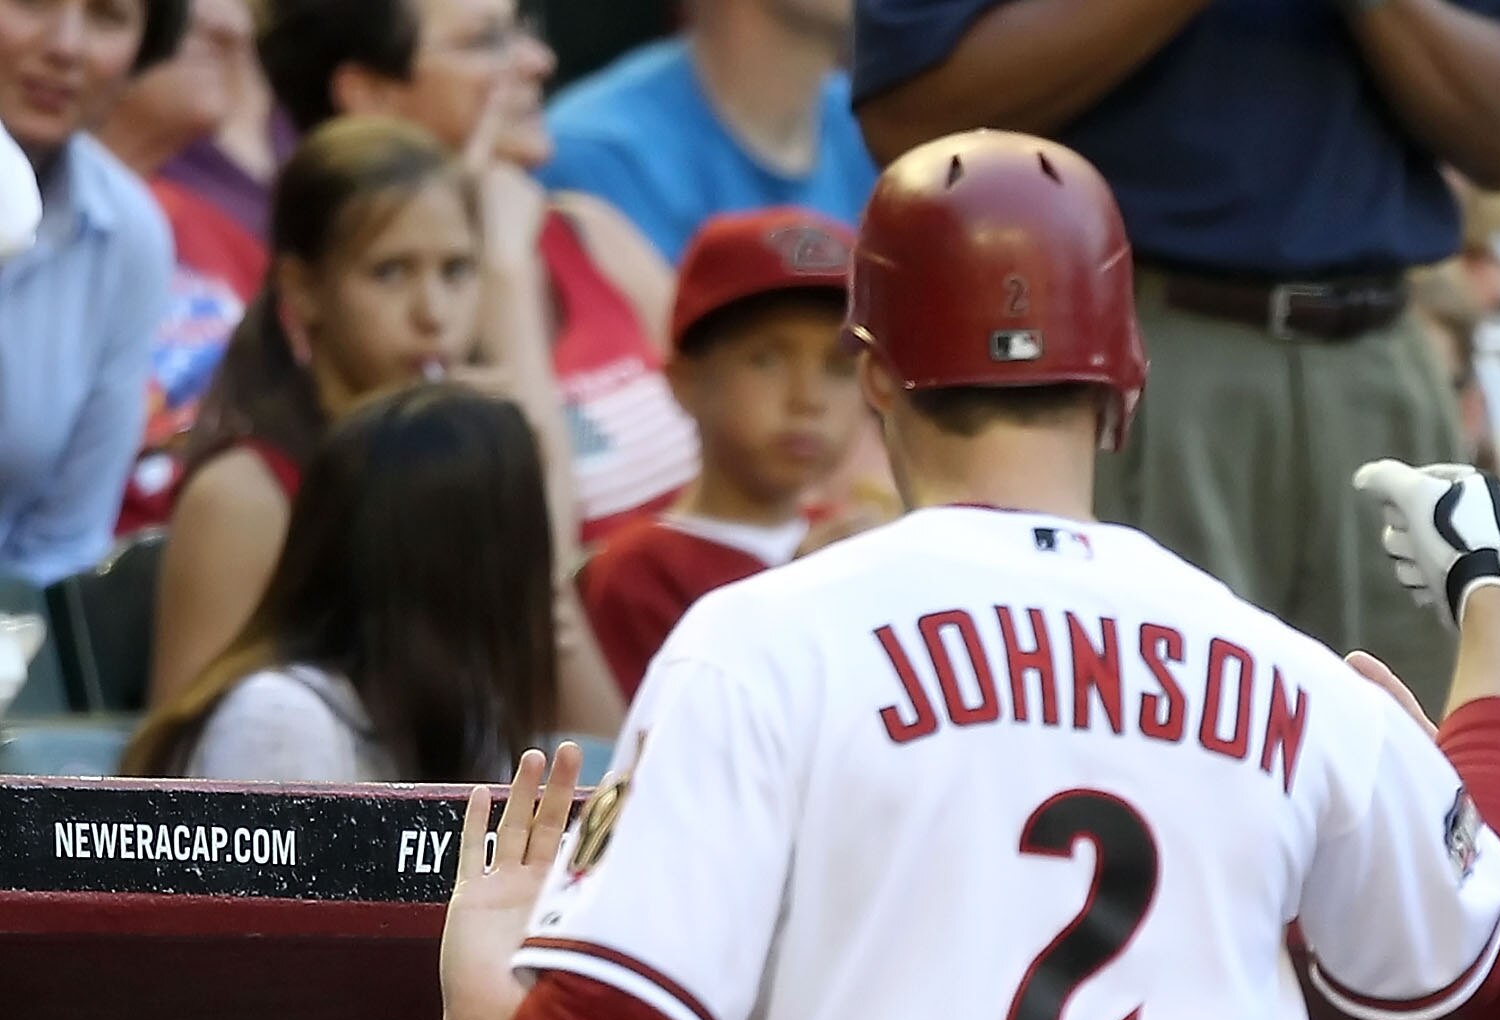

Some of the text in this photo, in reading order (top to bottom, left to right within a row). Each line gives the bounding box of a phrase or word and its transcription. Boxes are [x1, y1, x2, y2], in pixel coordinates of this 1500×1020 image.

[1003, 274, 1030, 317] 2
[872, 604, 1310, 795] JOHNSON
[54, 821, 297, 866] NEWERACAP.COM
[398, 830, 452, 874] FLY
